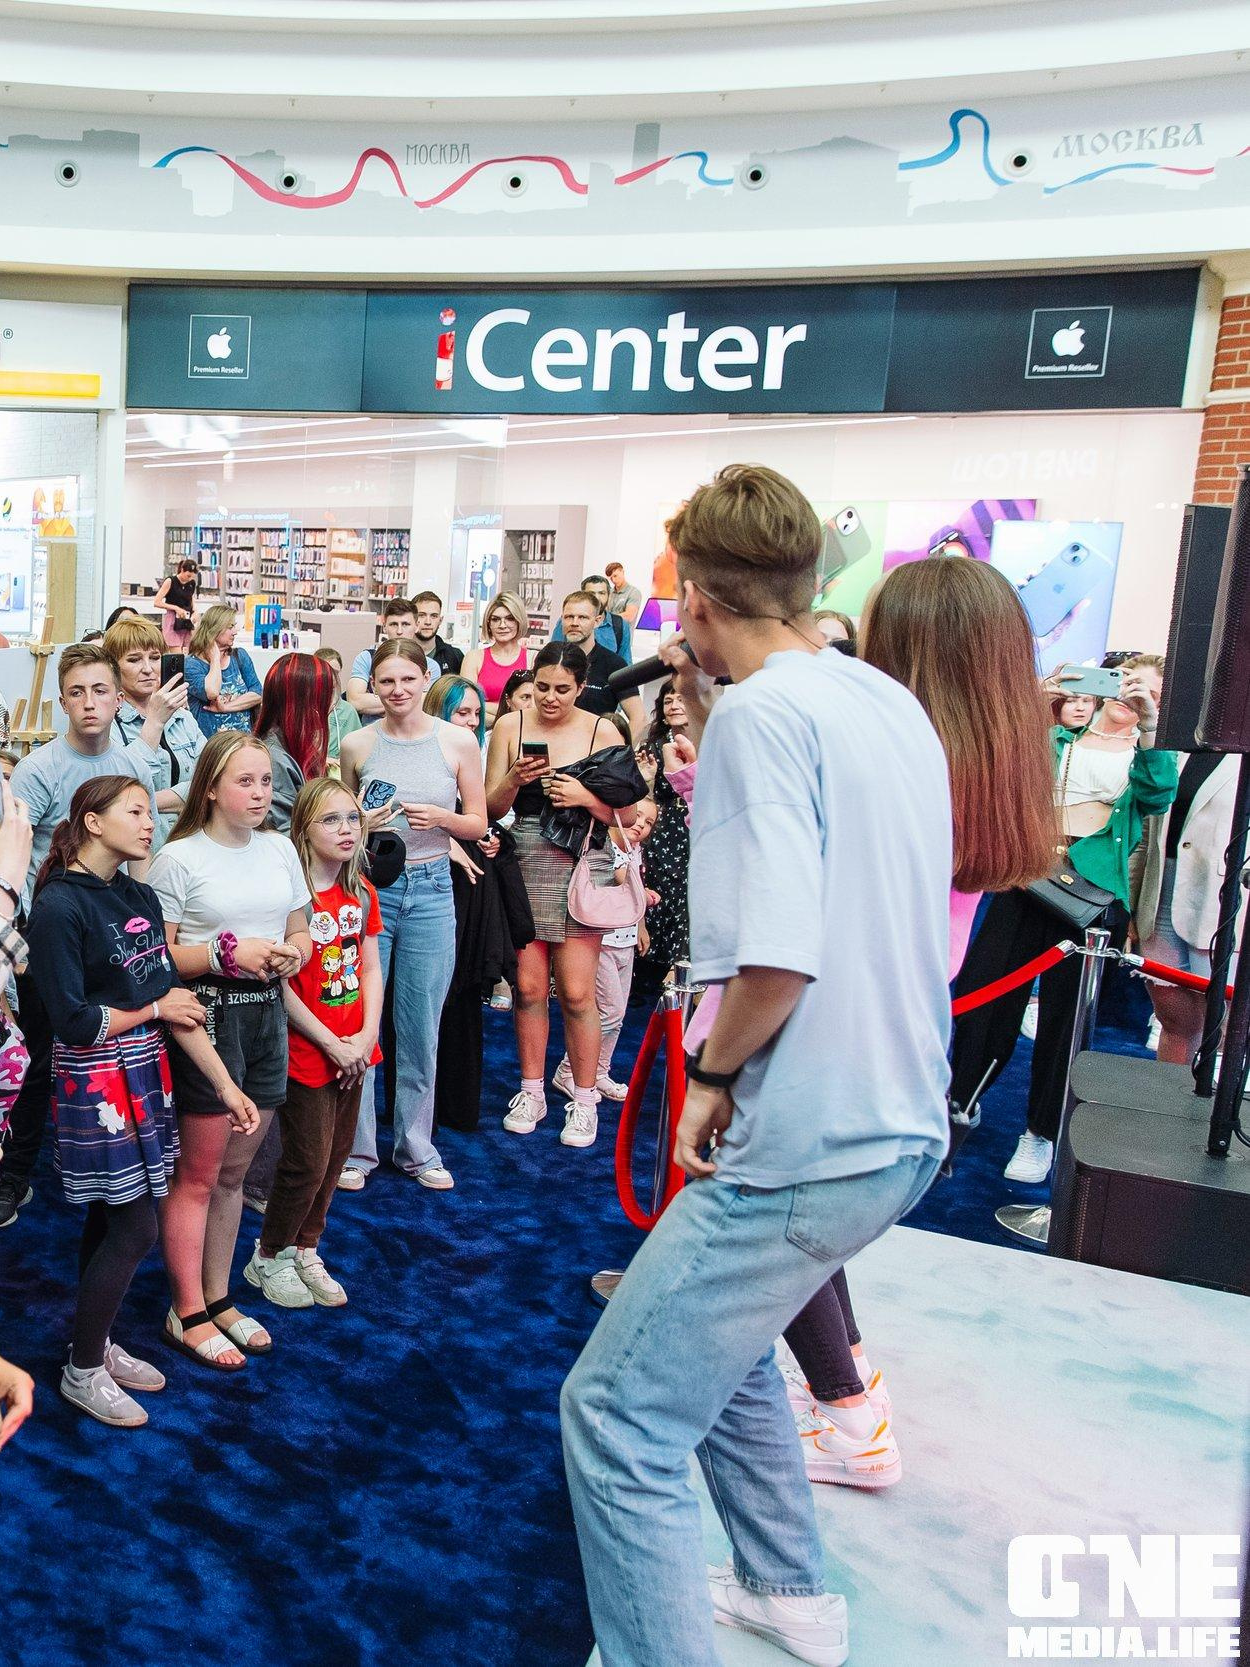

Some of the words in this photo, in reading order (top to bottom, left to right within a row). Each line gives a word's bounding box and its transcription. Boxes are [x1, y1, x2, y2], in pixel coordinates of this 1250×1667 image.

[1052, 122, 1205, 158] МОСКВА
[406, 143, 470, 165] МОСКВА
[434, 307, 807, 393] iCenter
[221, 366, 244, 374] Reseller
[1032, 364, 1067, 373] Premium
[1068, 363, 1099, 372] Reseller
[108, 923, 123, 940] I
[129, 955, 162, 985] Girls
[869, 1463, 885, 1472] AIR
